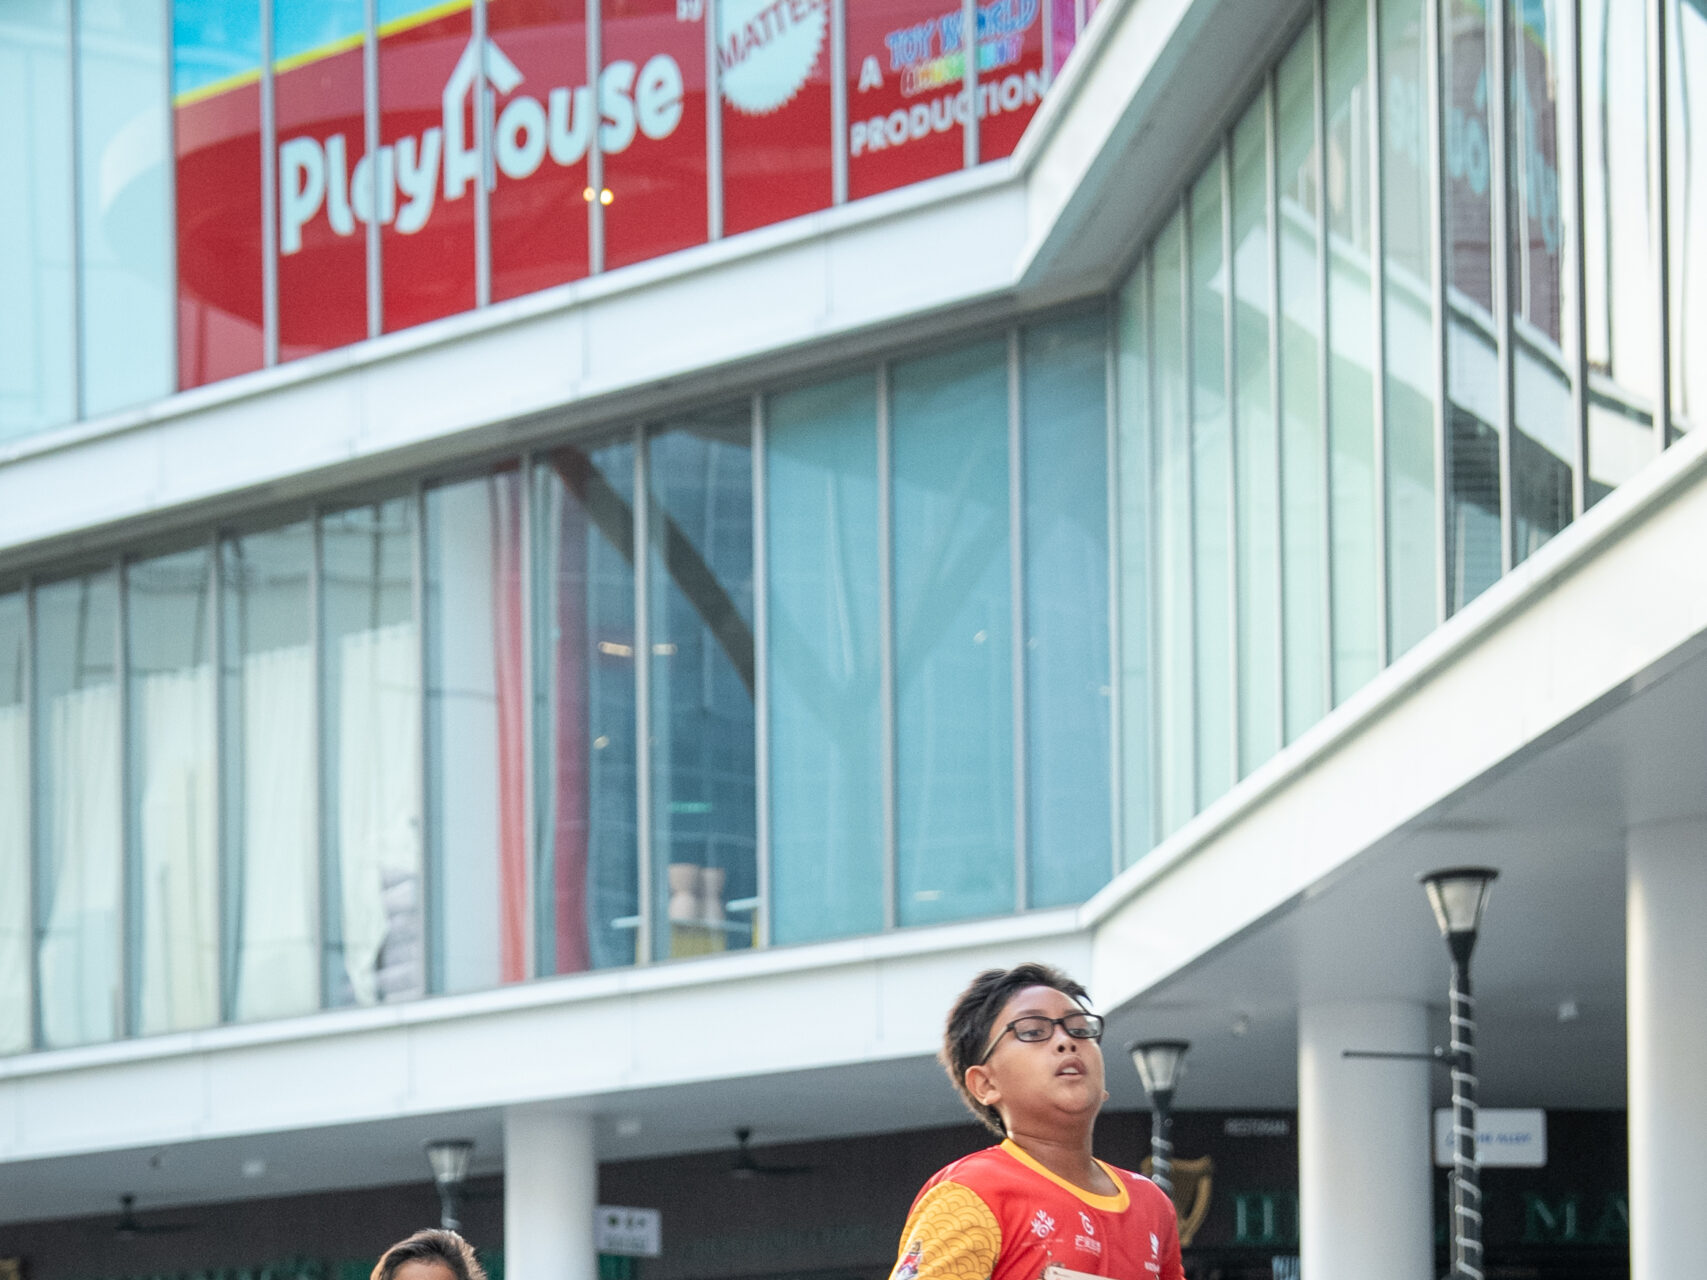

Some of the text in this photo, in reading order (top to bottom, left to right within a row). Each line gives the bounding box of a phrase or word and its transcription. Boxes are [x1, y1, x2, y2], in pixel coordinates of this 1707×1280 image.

[886, 19, 936, 71] TOY
[857, 55, 884, 94] A
[850, 69, 1050, 156] PRODUCTION
